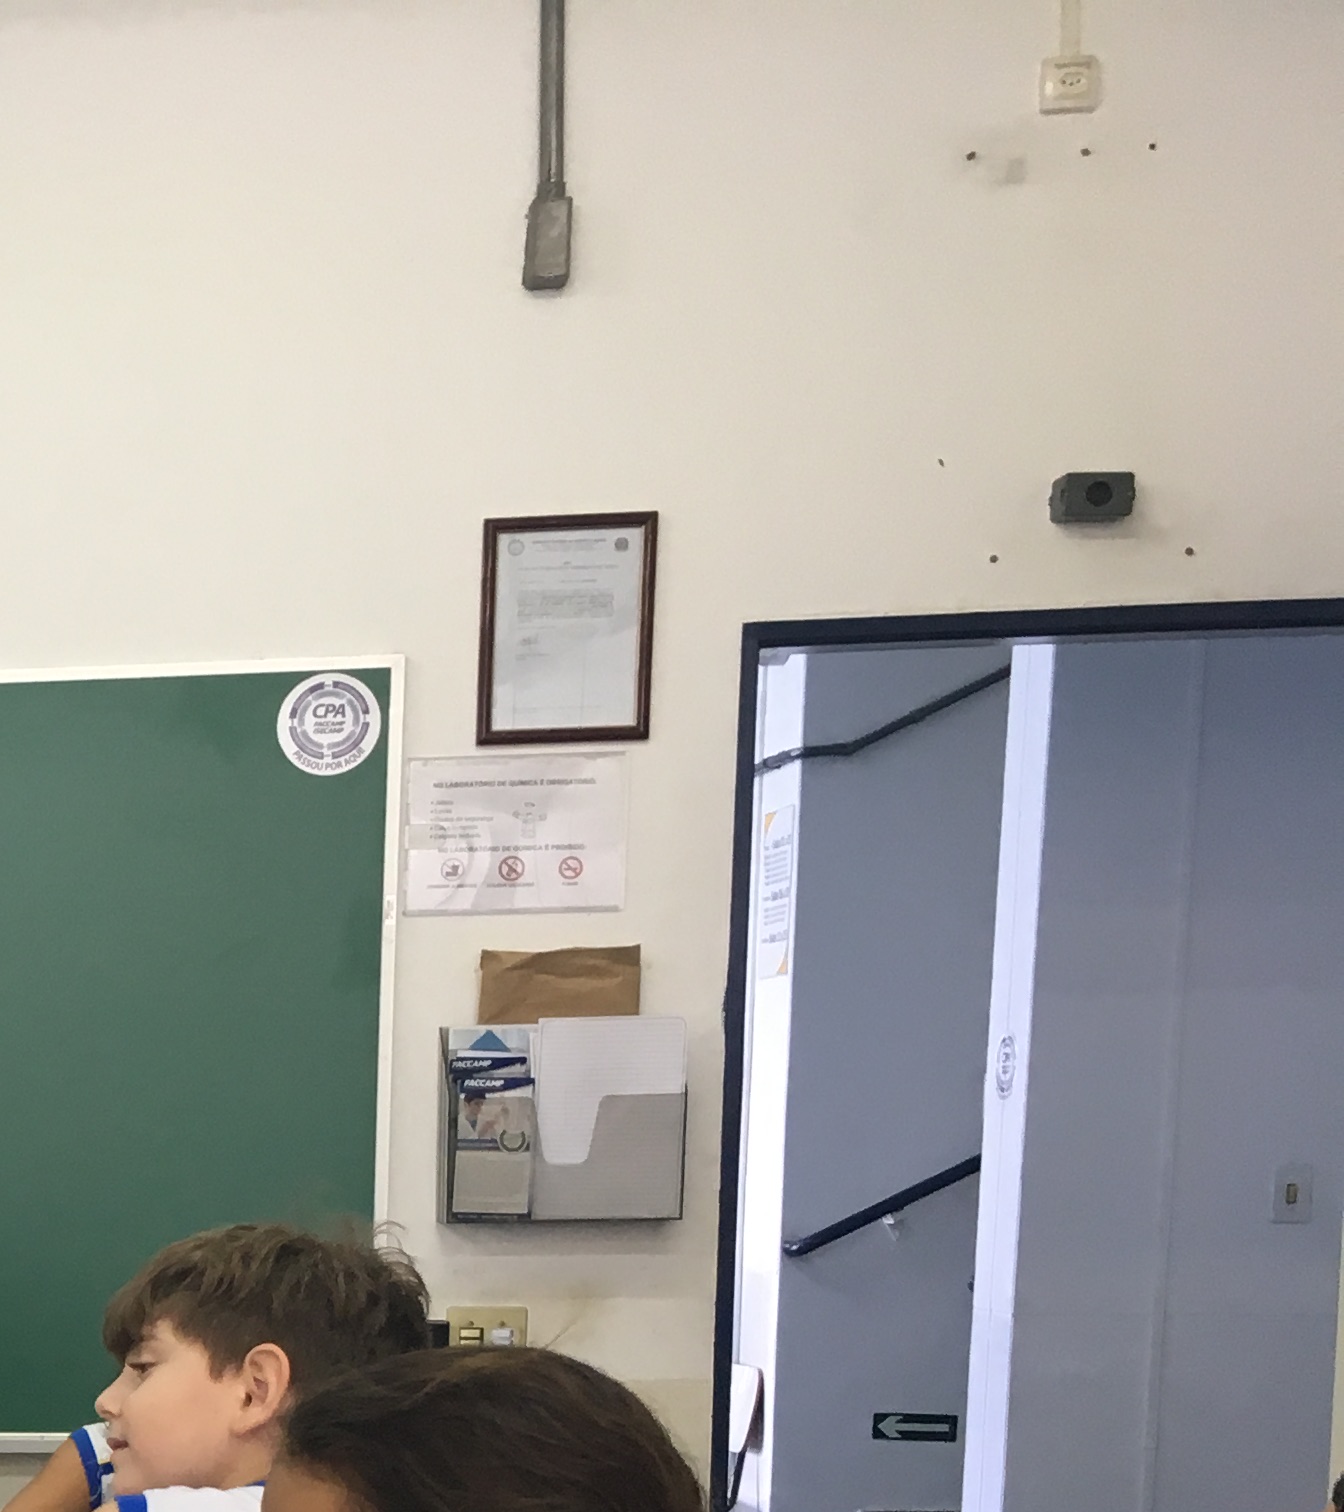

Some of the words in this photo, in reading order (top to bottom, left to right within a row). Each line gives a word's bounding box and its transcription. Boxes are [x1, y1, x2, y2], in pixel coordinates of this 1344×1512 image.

[312, 703, 346, 719] CPA
[292, 749, 324, 771] PASSOU
[325, 760, 343, 771] POR
